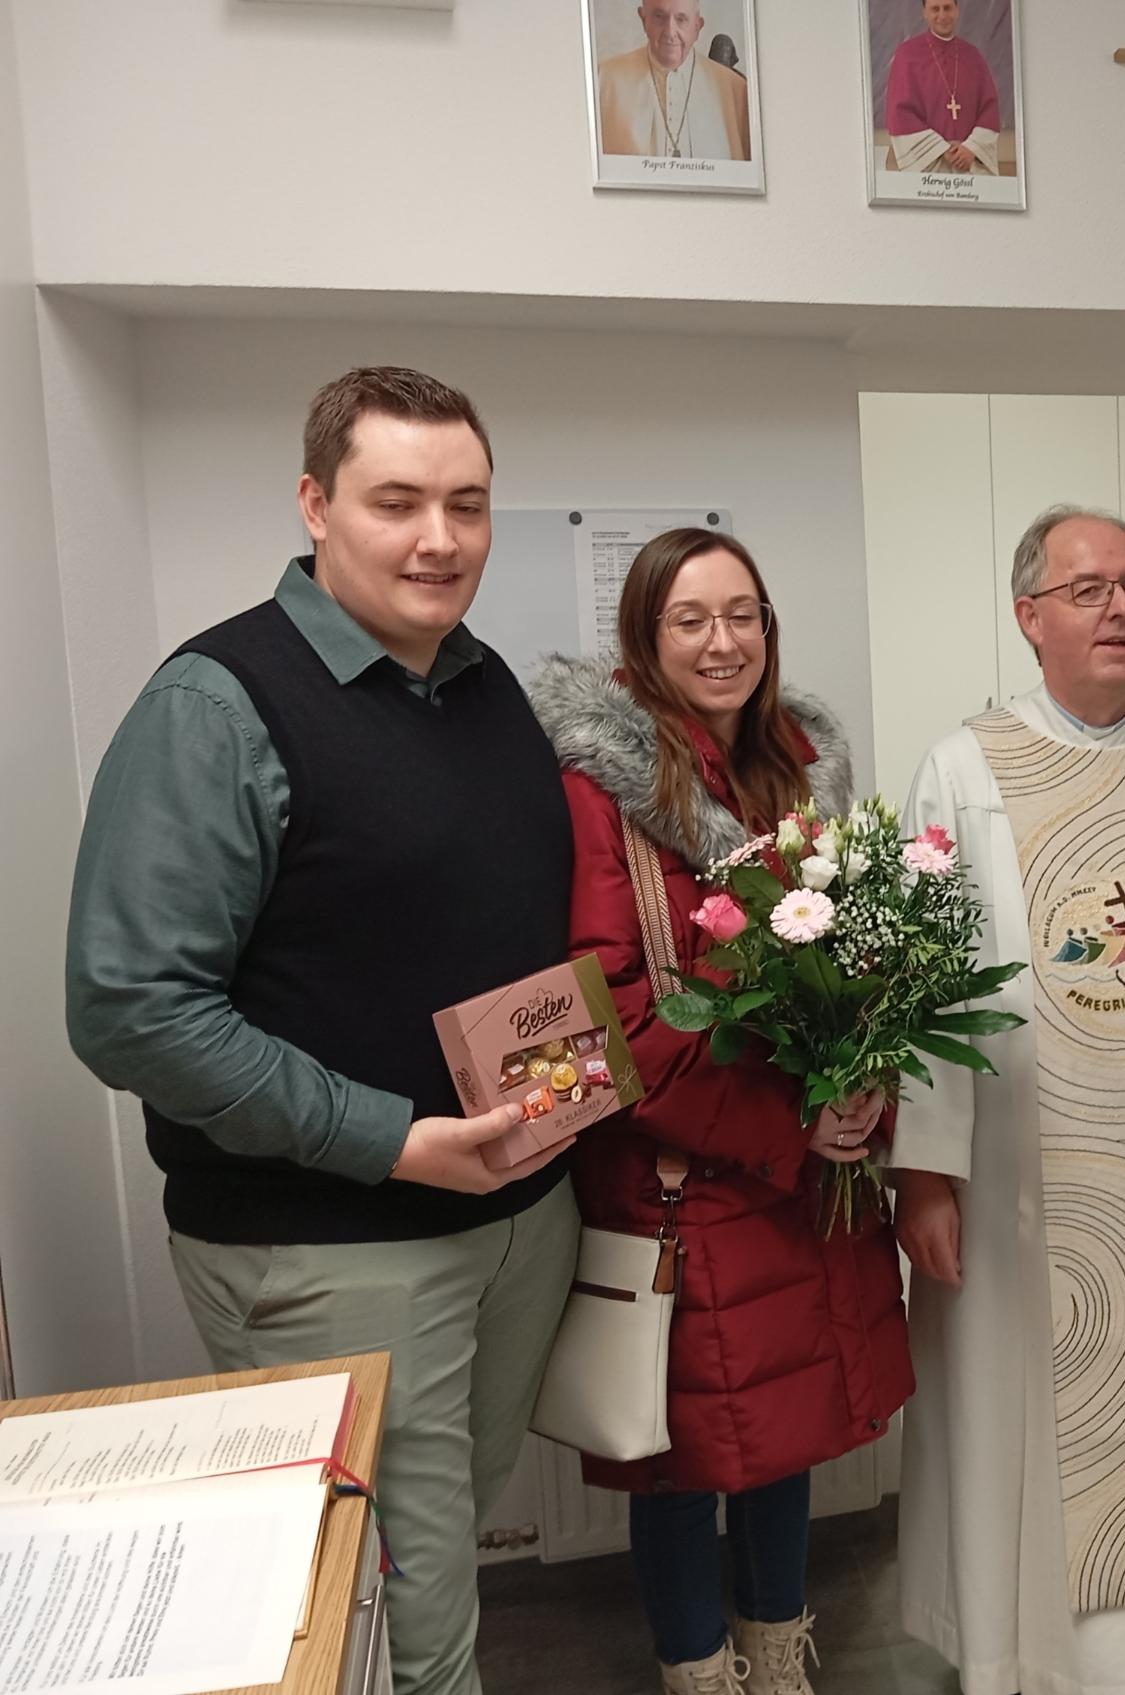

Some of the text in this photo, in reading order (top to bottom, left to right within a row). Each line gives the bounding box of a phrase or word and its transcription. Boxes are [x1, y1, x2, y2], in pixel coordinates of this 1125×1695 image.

[642, 160, 715, 172] Papst Franziskus
[922, 174, 952, 190] Herwig
[509, 993, 573, 1039] Besten
